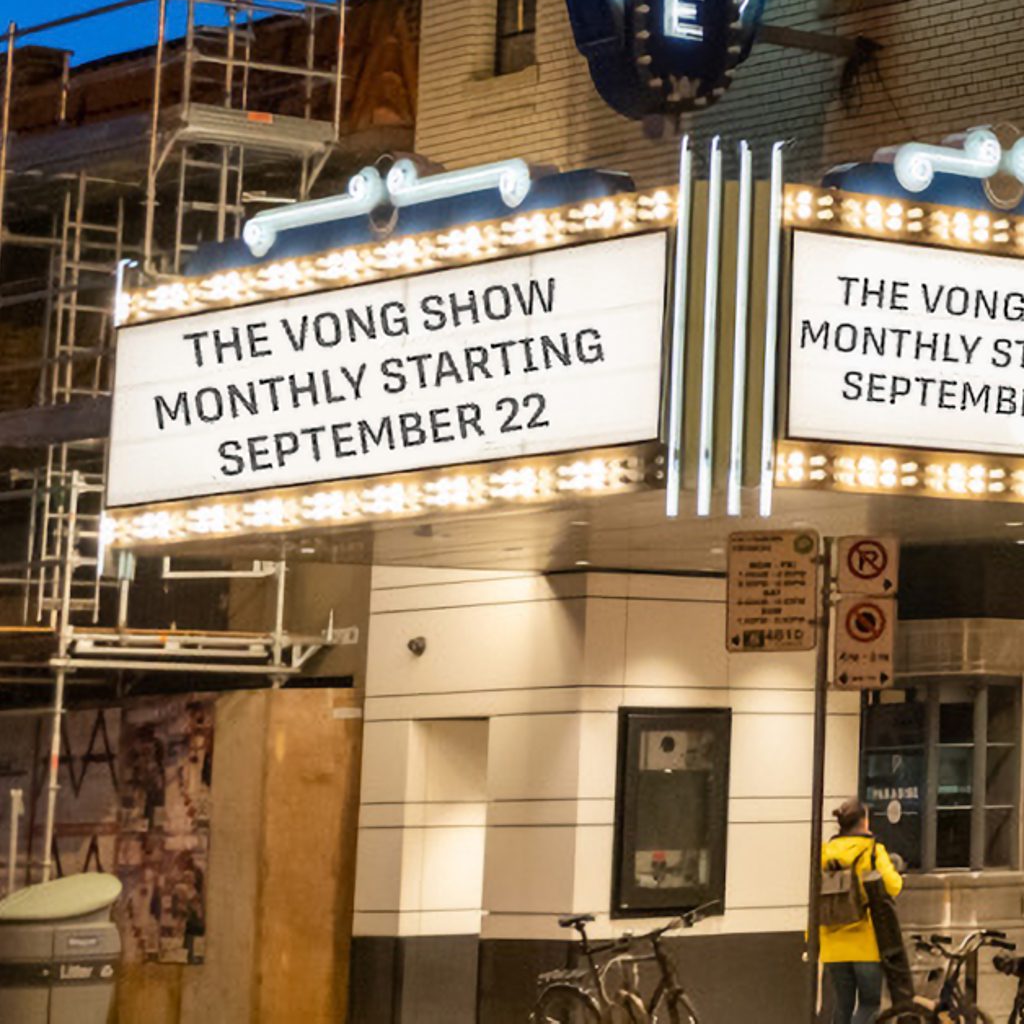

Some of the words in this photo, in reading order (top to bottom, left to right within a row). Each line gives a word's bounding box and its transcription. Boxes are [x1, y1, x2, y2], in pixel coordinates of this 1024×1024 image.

[184, 321, 274, 367] THE
[281, 301, 410, 352] VONG
[421, 277, 556, 330] SHOW
[838, 276, 909, 311] THE
[153, 363, 367, 429] MONTHLY
[382, 328, 605, 394] STARTING
[799, 320, 982, 364] MONTHLY
[218, 403, 484, 476] SEPTEMBER
[495, 392, 550, 433] 22
